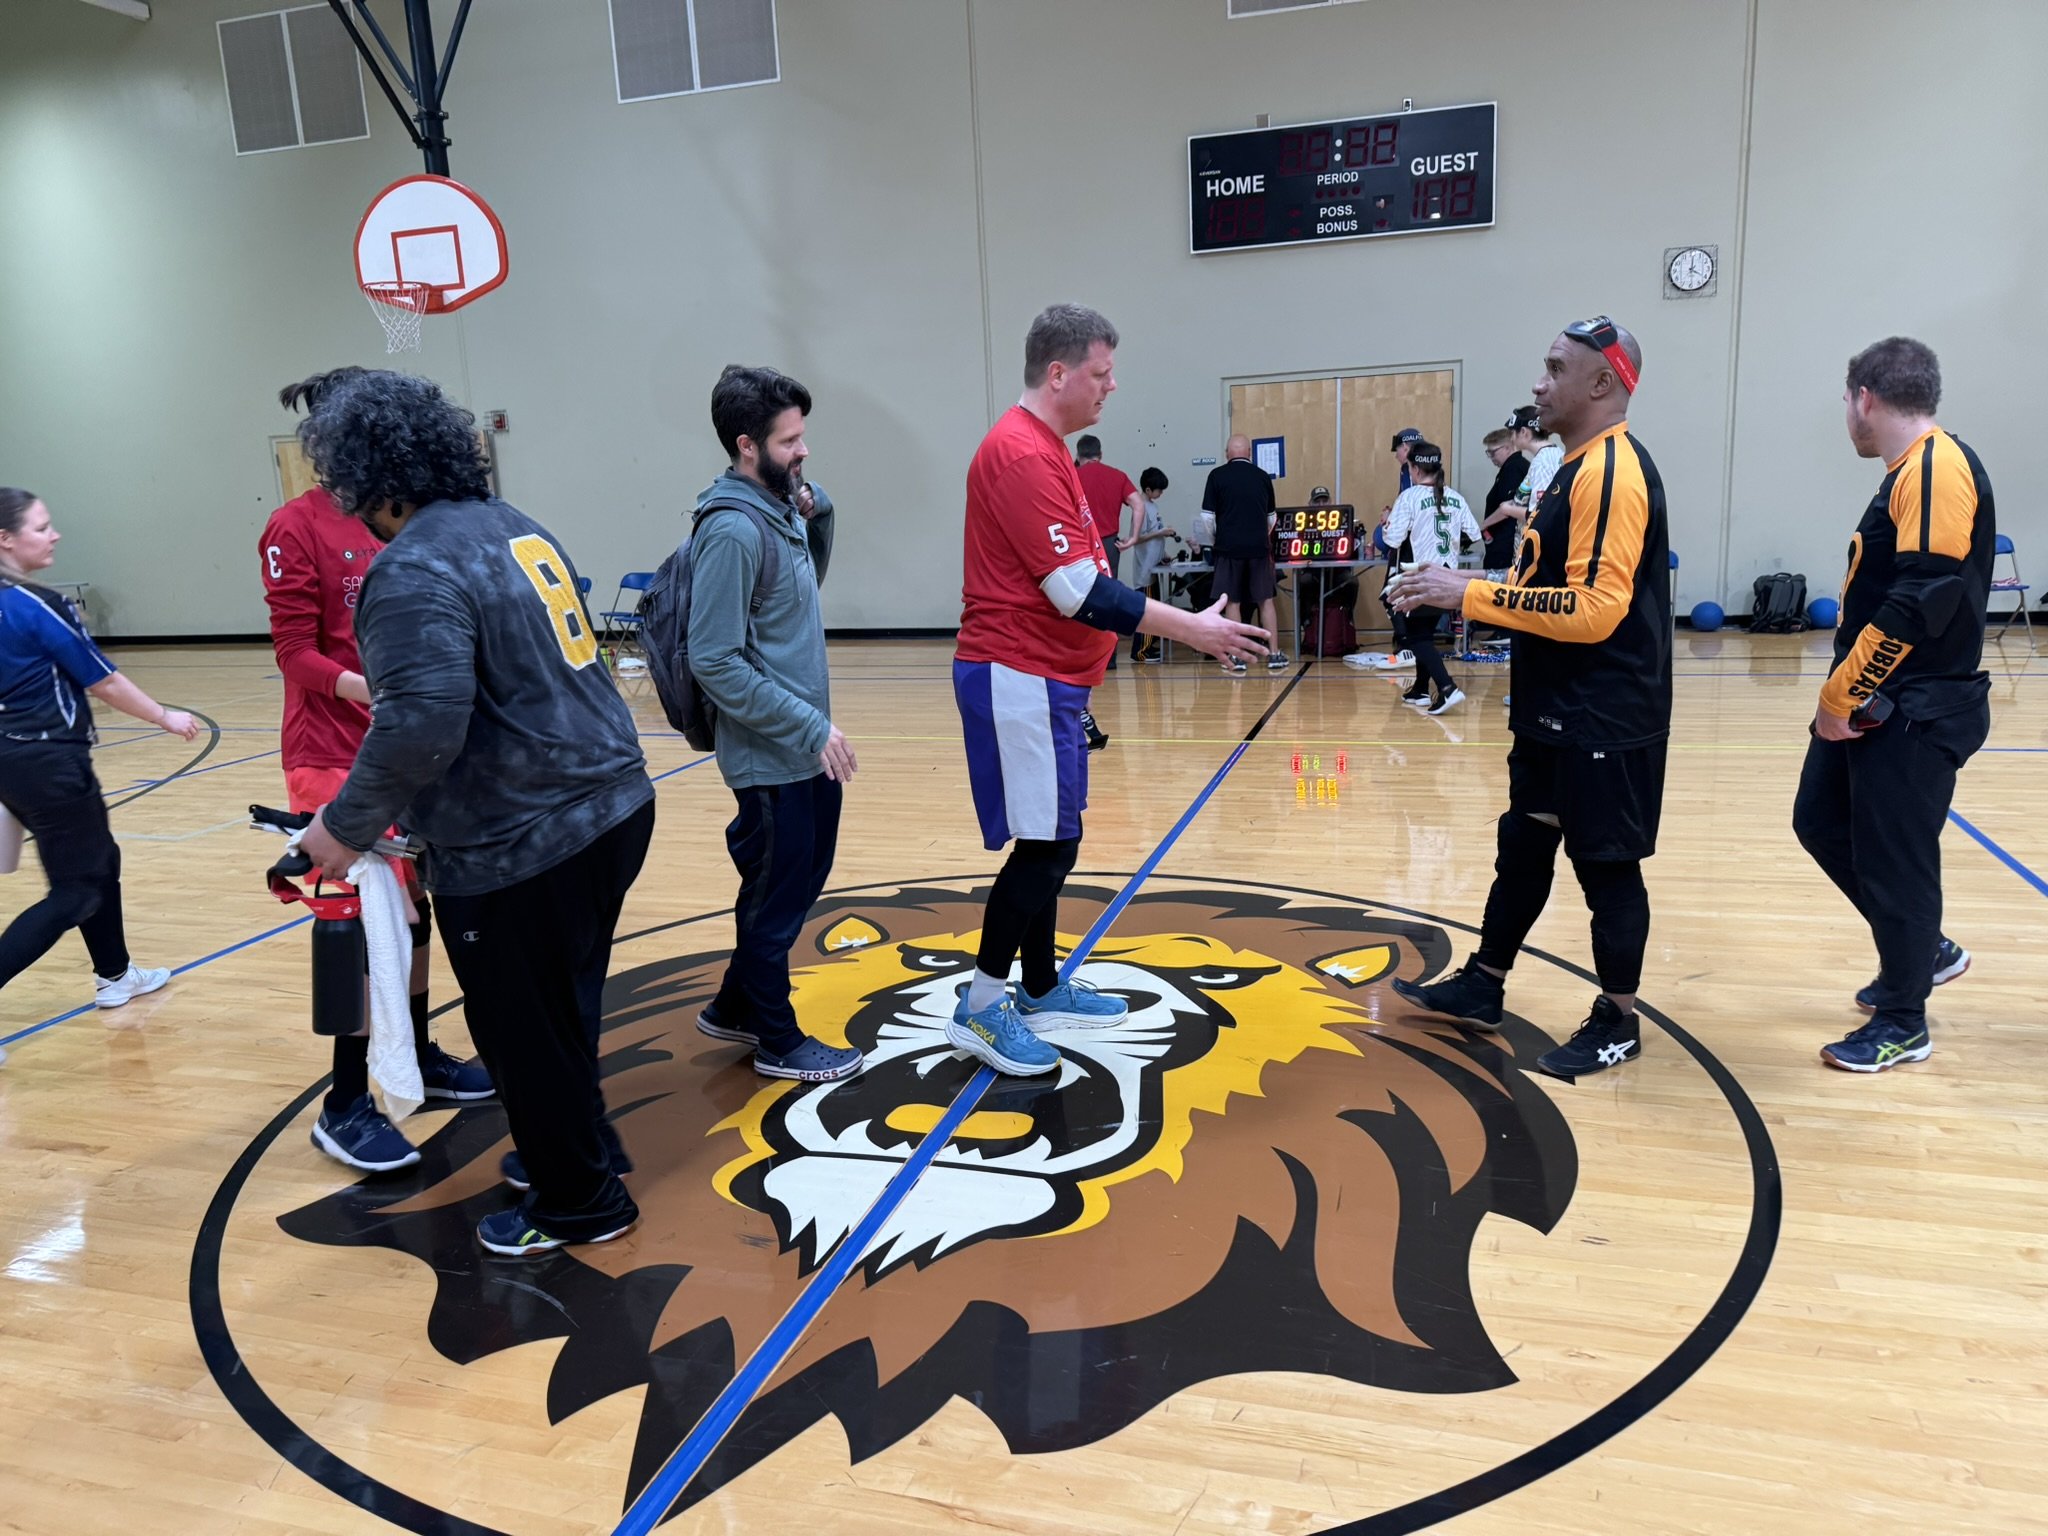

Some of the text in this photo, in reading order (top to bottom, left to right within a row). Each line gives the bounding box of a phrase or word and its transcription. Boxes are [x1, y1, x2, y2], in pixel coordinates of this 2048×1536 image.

[1411, 152, 1479, 176] GUEST
[1206, 174, 1265, 198] HOME
[1317, 171, 1359, 186] PERIOD
[1320, 205, 1356, 218] POSS.
[1317, 219, 1358, 234] BONUS
[1294, 510, 1340, 531] 9:58
[1047, 522, 1070, 554] 5
[1278, 531, 1299, 539] HOME
[1321, 529, 1345, 538] GUEST
[1434, 513, 1451, 557] 5
[508, 533, 598, 671] 8
[1492, 588, 1577, 615] COBRAS
[1848, 637, 1904, 700] OBRAS
[966, 1016, 996, 1046] HOKA
[799, 1069, 839, 1080] crocs
